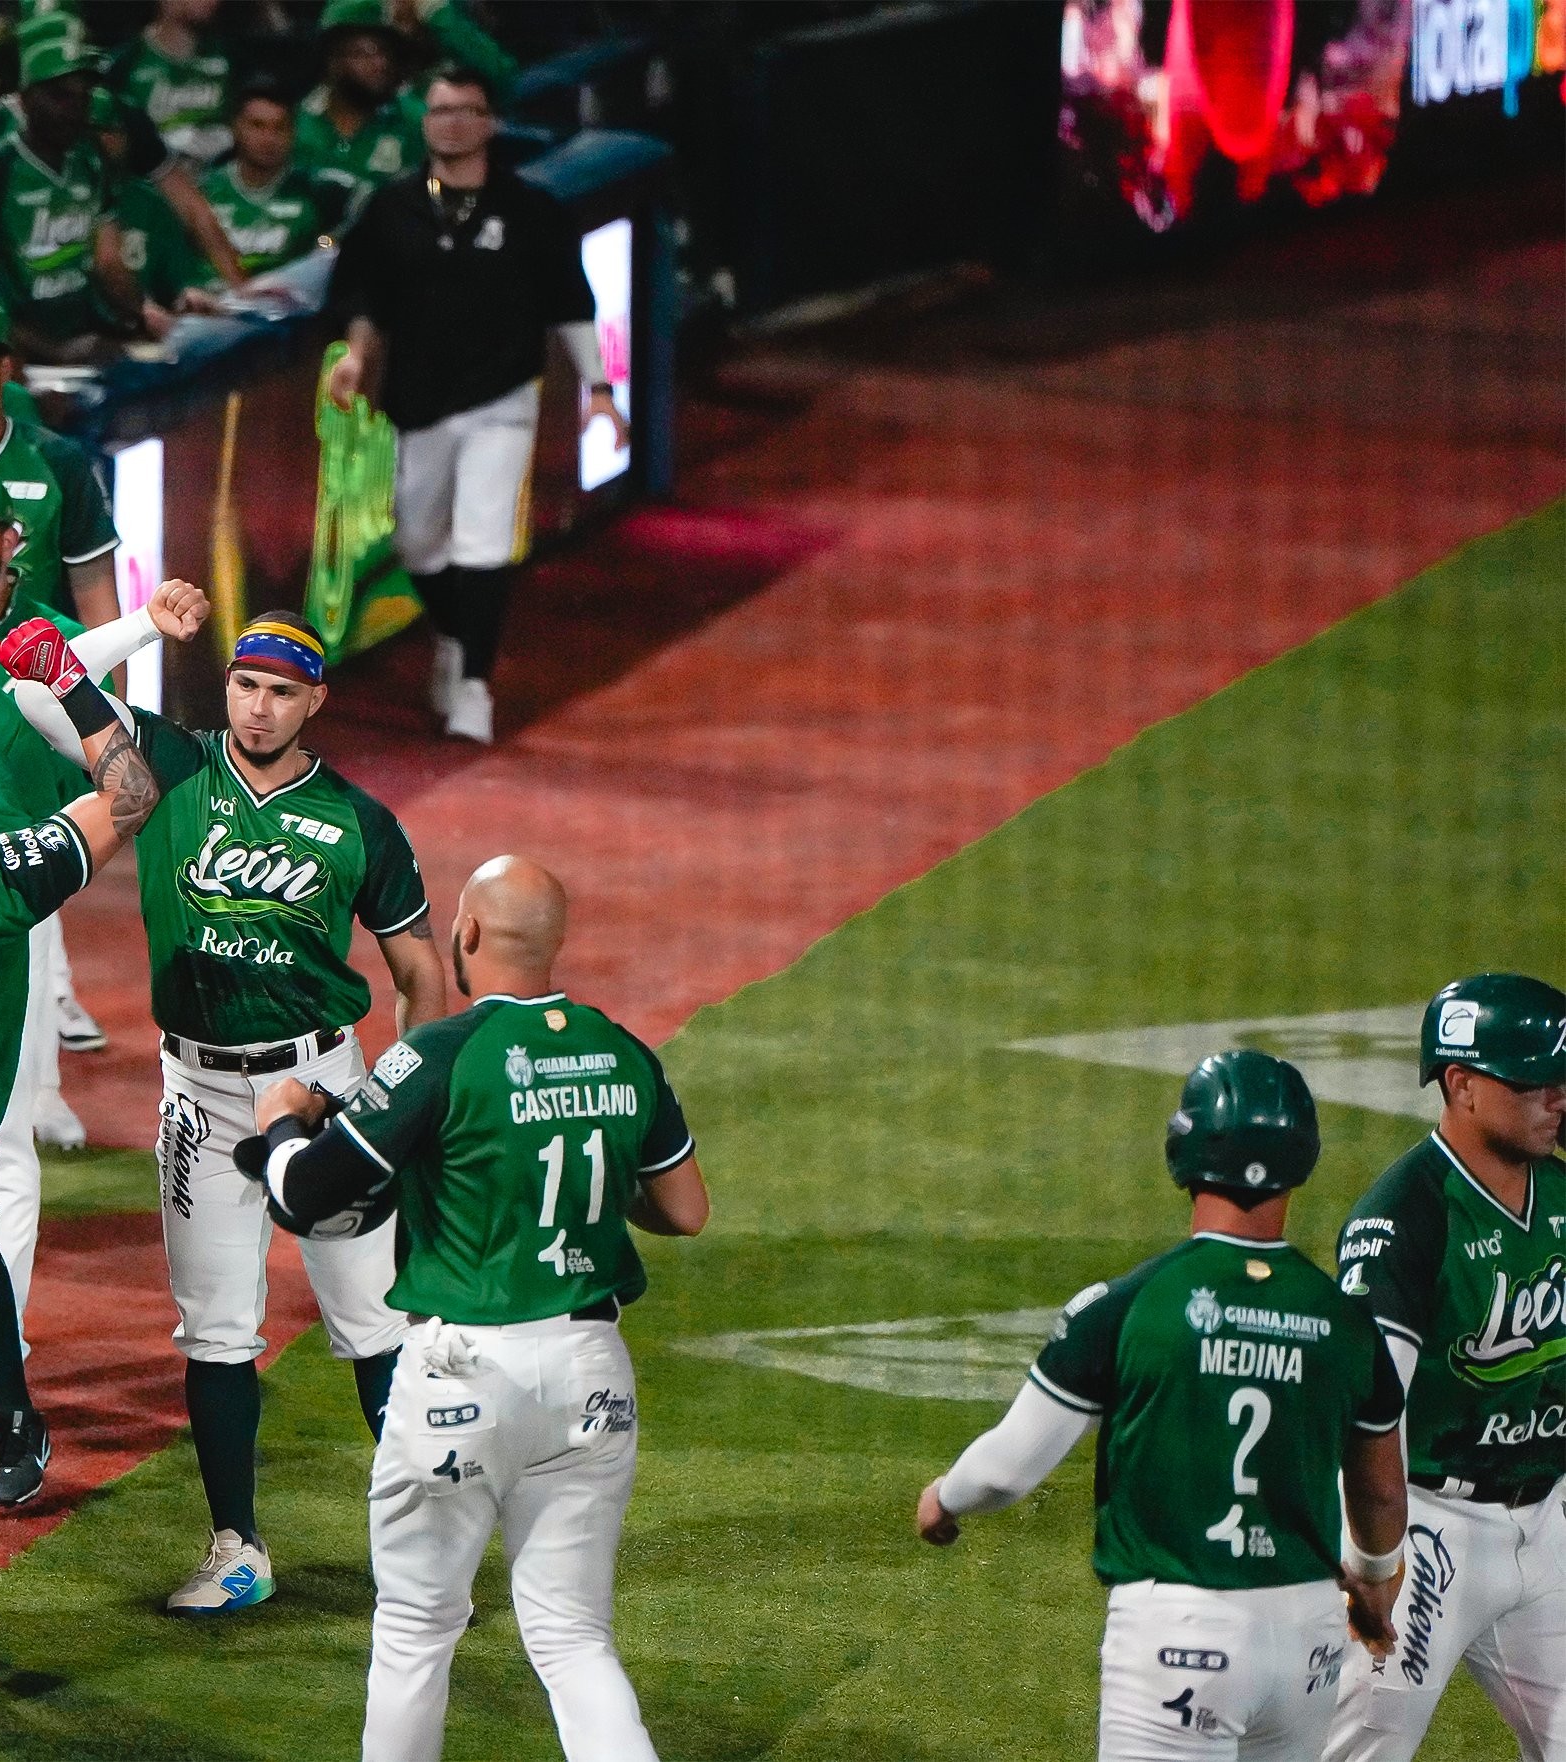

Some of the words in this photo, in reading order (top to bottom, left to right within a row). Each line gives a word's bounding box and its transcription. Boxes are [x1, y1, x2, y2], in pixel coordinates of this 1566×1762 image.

[279, 813, 344, 845] TEB
[189, 824, 320, 902] León
[535, 1053, 617, 1075] GUANAJUATO
[510, 1084, 637, 1124] CASTELLANO
[172, 1092, 212, 1220] Caliente
[538, 1128, 604, 1228] 11
[1346, 1217, 1396, 1238] Corona
[1224, 1305, 1331, 1337] GUANAJUATO
[1465, 1262, 1566, 1361] Leó
[1200, 1338, 1302, 1384] MEDINA
[1227, 1386, 1272, 1496] 2
[1400, 1523, 1456, 1686] Caliente
